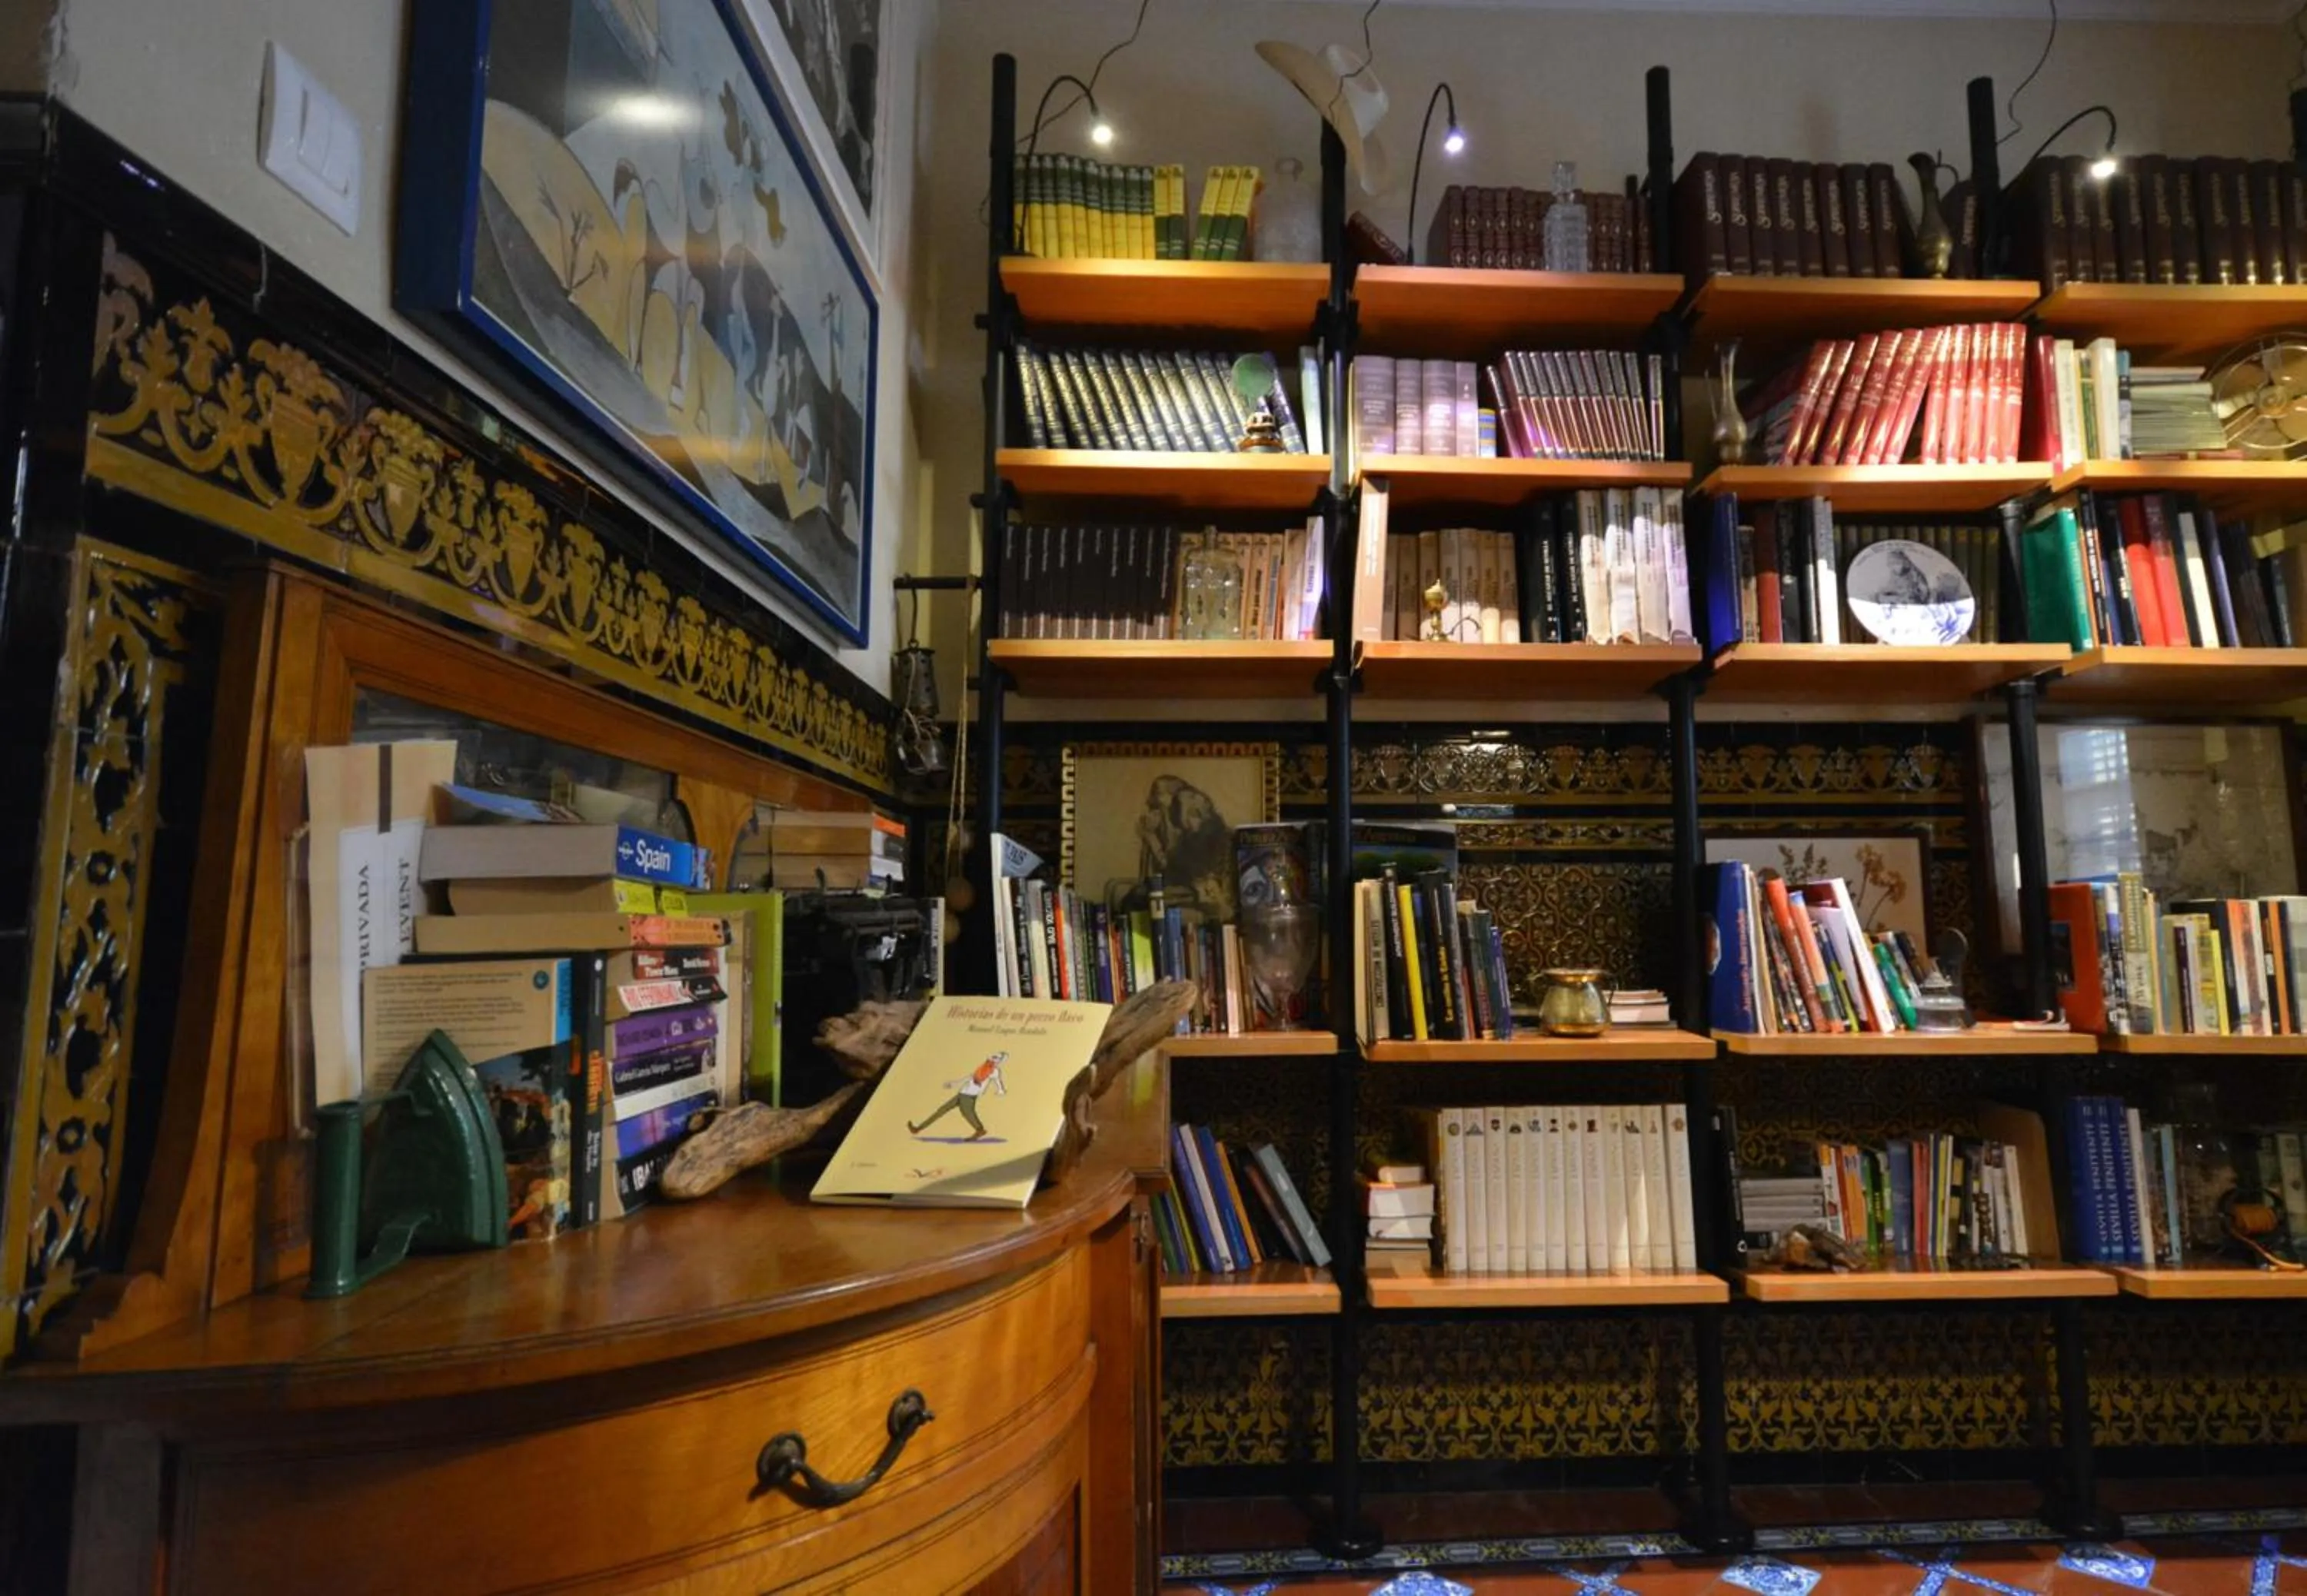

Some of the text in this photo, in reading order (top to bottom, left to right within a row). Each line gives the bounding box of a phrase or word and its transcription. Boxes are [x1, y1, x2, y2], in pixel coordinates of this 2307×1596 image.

[635, 839, 671, 873] Spain
[358, 862, 370, 967] RIVADA
[398, 857, 411, 943] EVENT
[947, 1005, 994, 1020] Historias
[995, 1007, 1009, 1020] de
[1010, 1012, 1026, 1021] un
[1024, 1012, 1056, 1025] perro
[2099, 1122, 2117, 1189] PENITENTE
[2108, 1192, 2122, 1242] SEVILLA
